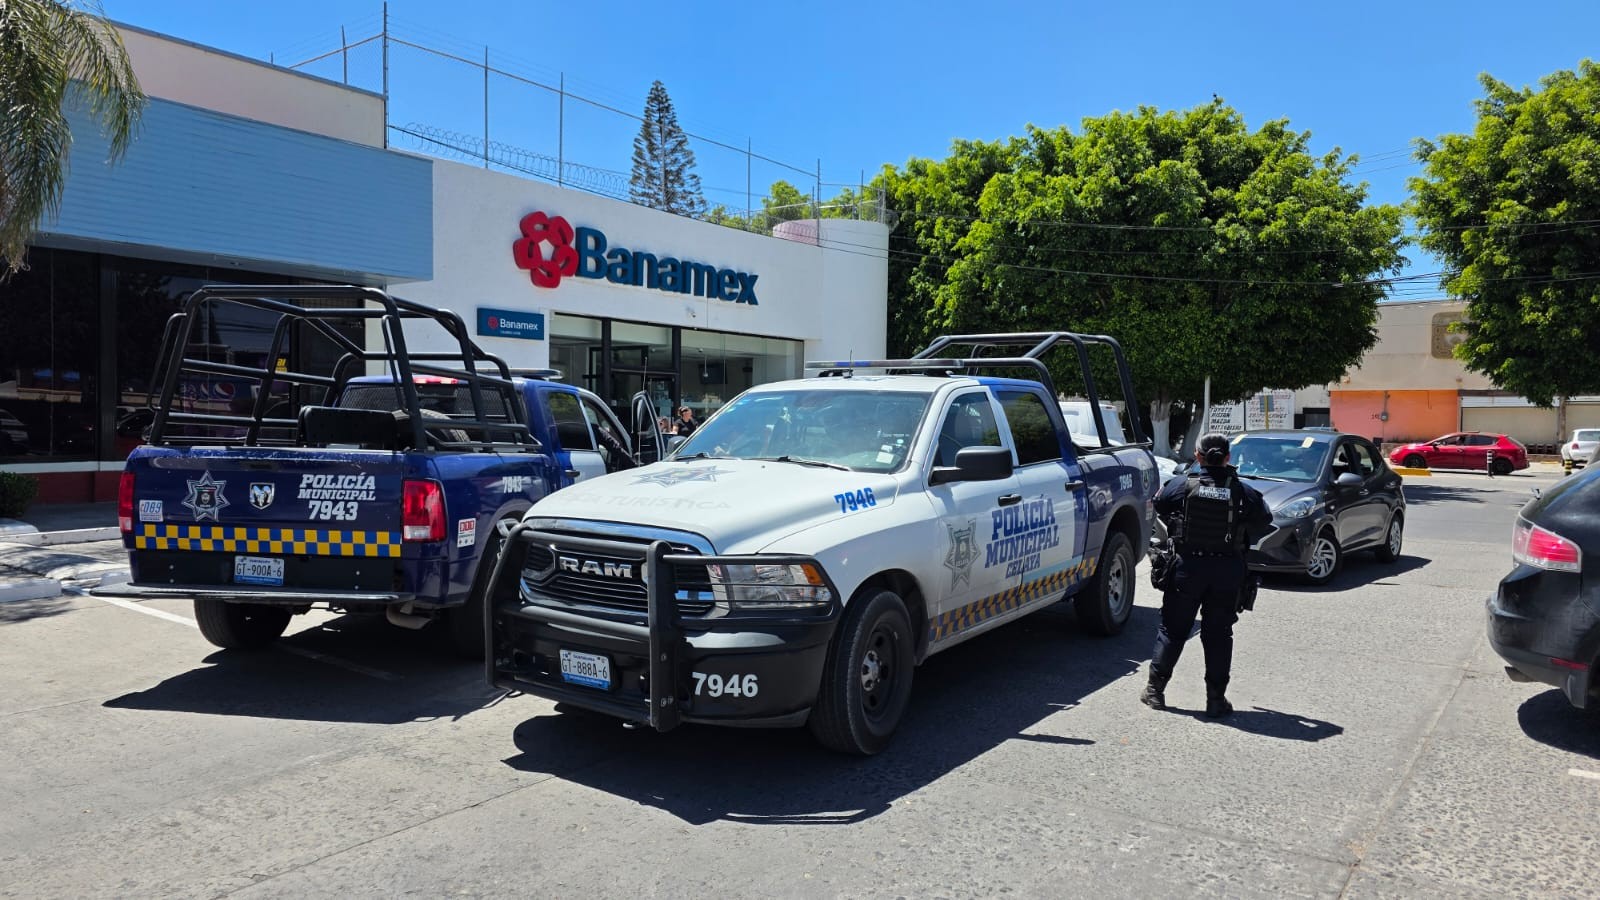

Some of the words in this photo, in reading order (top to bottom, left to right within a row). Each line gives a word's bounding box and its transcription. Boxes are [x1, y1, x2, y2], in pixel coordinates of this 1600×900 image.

[575, 226, 759, 306] Banamex
[500, 318, 539, 331] Banamex
[299, 472, 376, 490] POLICÍA
[502, 476, 522, 494] 7943
[297, 488, 377, 501] MUNICIPAL
[834, 487, 877, 514] 7946
[308, 499, 359, 521] 7943
[991, 494, 1056, 541] POLICÍA
[984, 524, 1059, 569] MUNICIPAL
[236, 563, 282, 577] GT-900A-6
[559, 556, 633, 579] RAM
[1005, 552, 1041, 579] CELAYA
[561, 658, 608, 679] GT-888A-6
[691, 671, 759, 698] 7946
